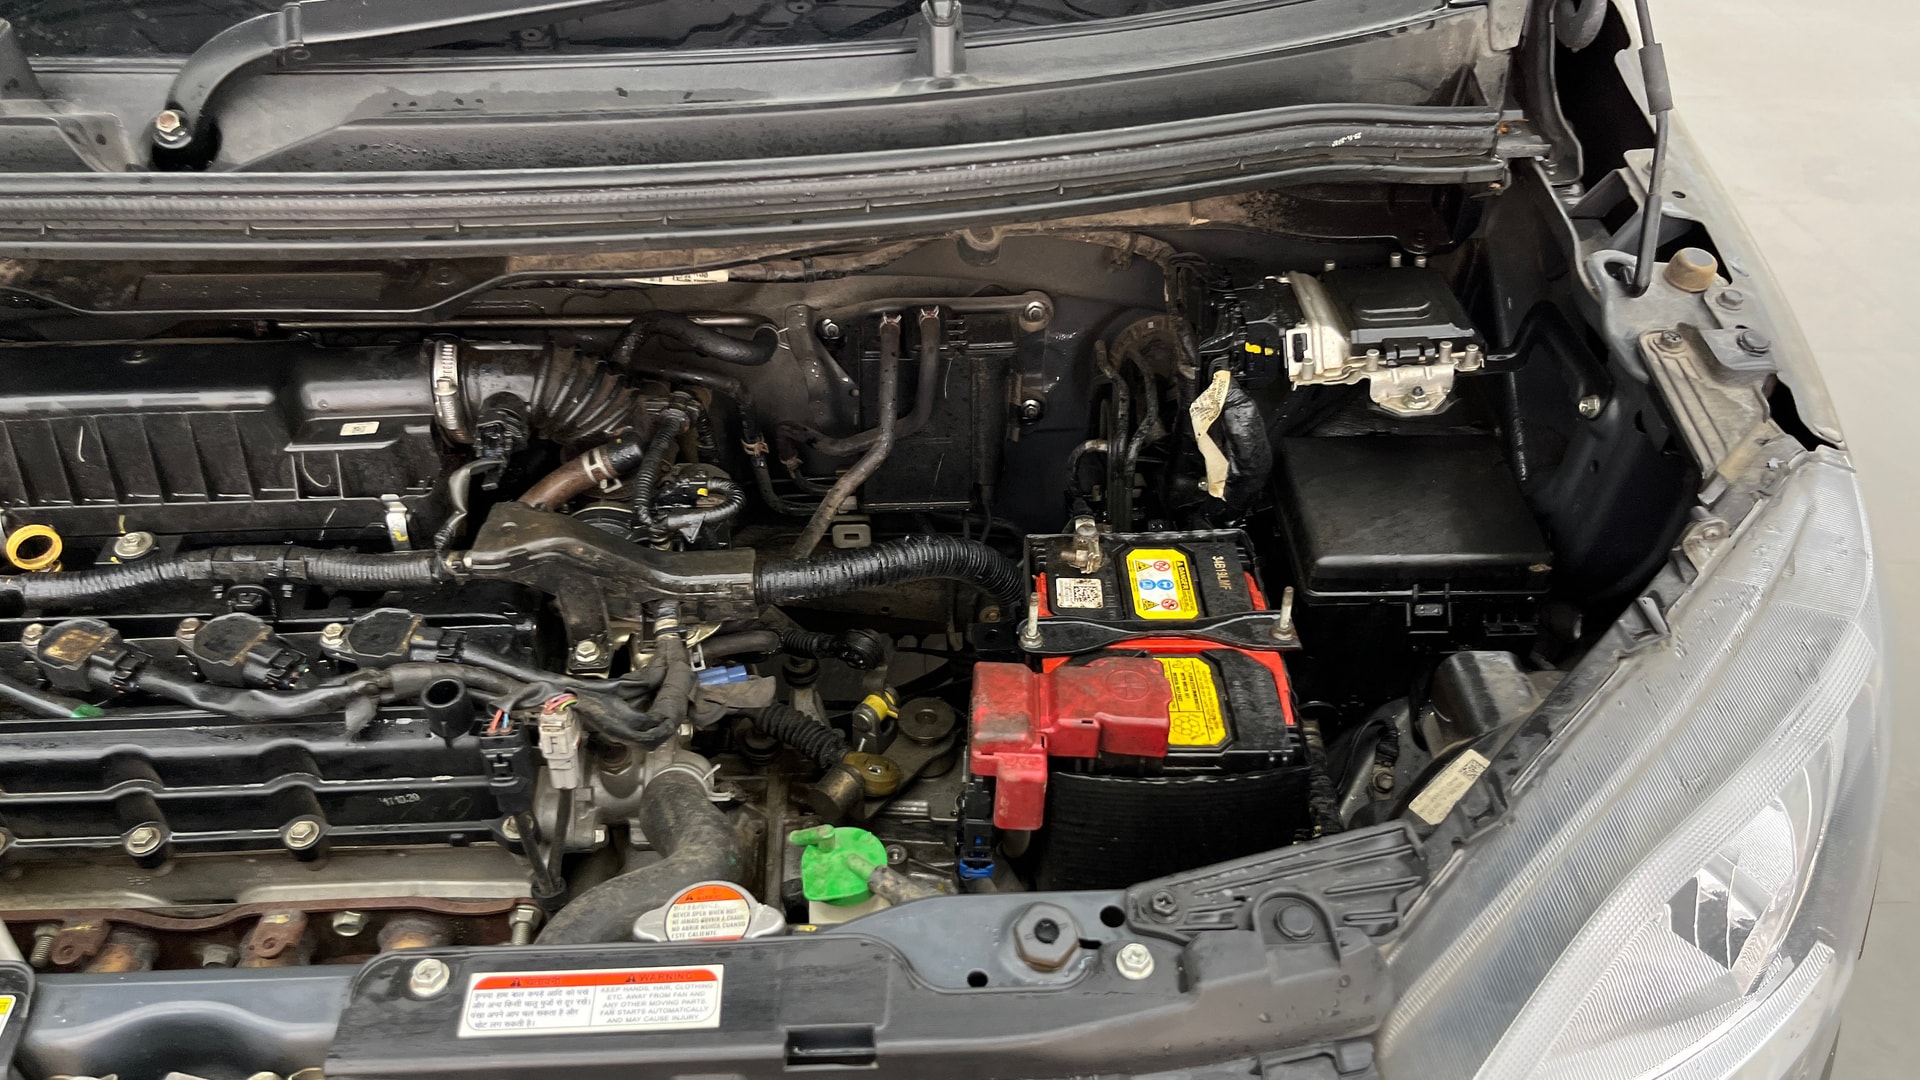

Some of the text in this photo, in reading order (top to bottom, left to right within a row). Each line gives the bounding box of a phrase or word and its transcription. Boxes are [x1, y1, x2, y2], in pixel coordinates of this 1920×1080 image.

[640, 972, 693, 982] WARNING
[674, 982, 714, 990] CLOTHING
[647, 1006, 709, 1014] AUTOMATICALLY
[643, 1014, 670, 1022] CAUSE
